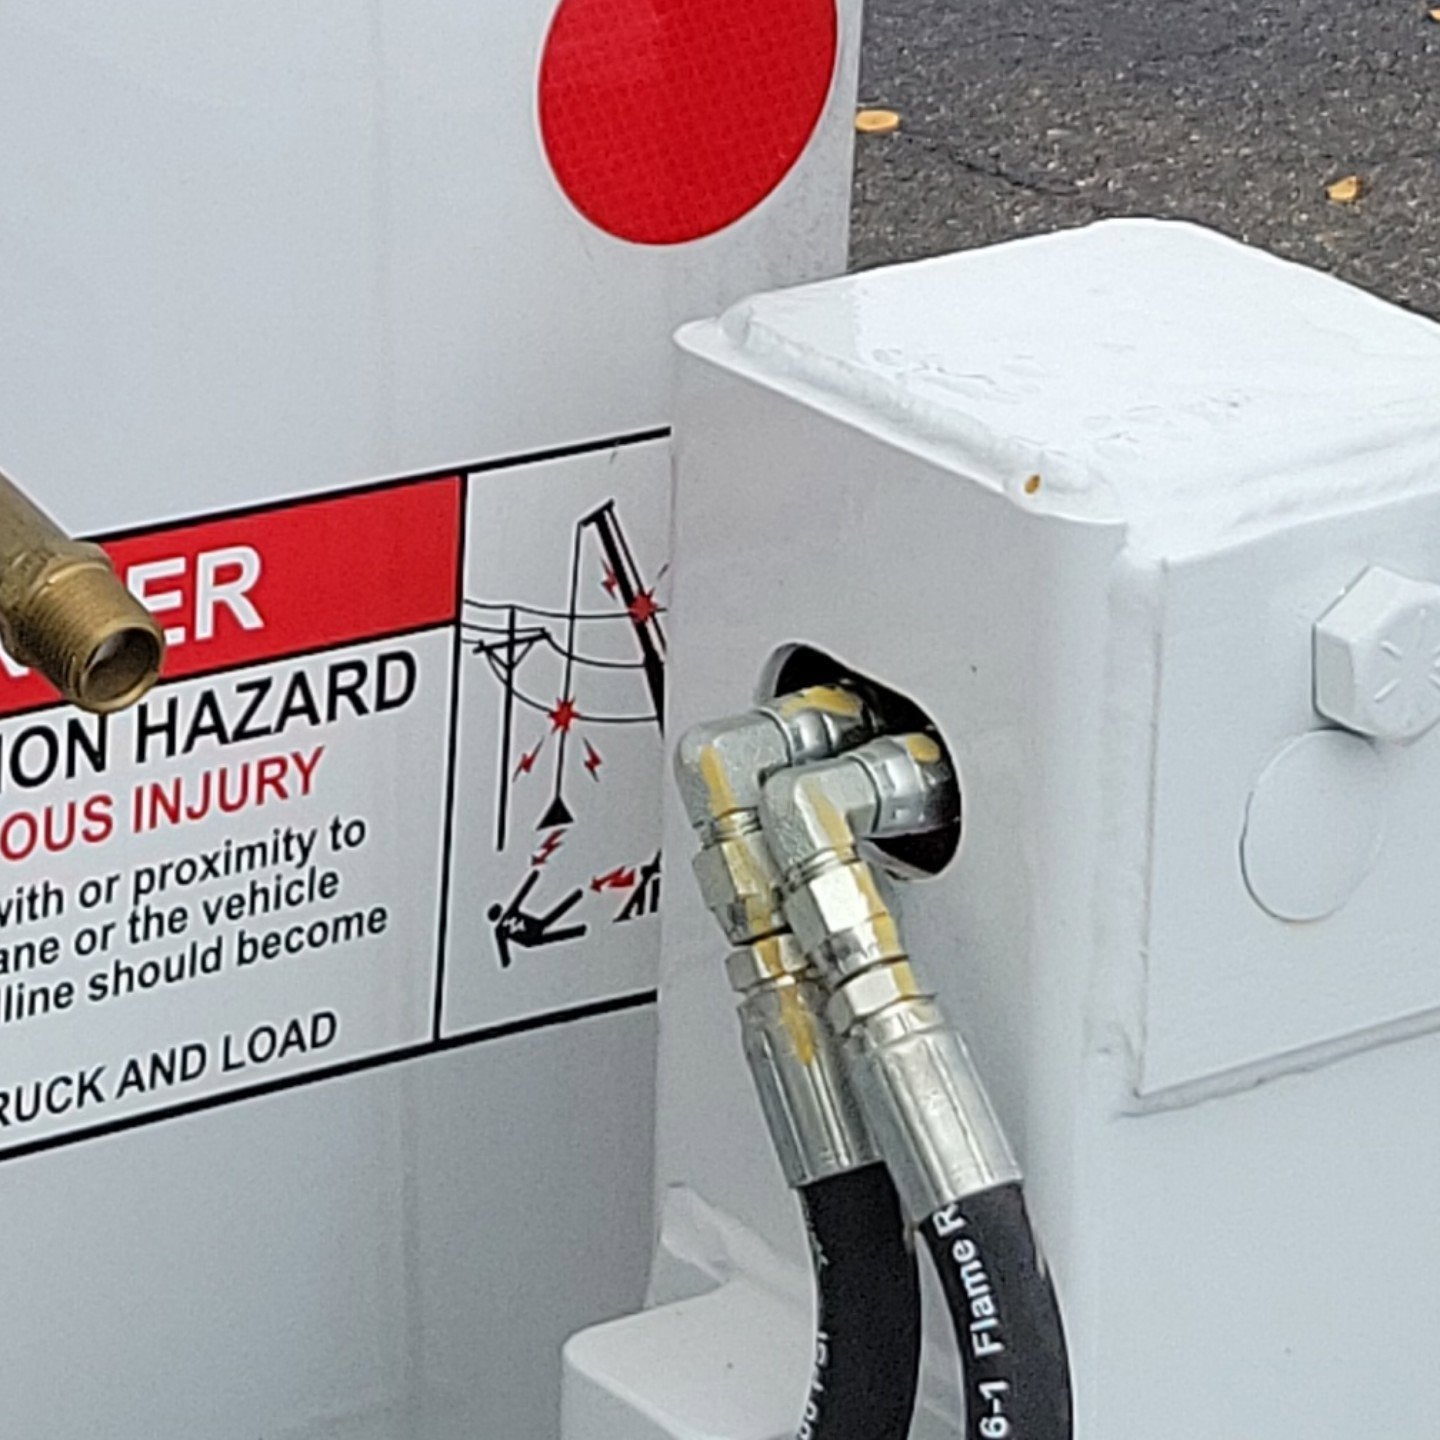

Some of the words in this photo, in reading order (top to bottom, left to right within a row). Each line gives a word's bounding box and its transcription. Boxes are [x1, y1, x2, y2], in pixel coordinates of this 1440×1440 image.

[136, 650, 417, 763] HAZARD
[132, 747, 324, 830] INJURY
[80, 875, 119, 907] or
[134, 829, 316, 906] proximity
[330, 817, 365, 851] to
[75, 923, 115, 955] or
[129, 906, 187, 943] the
[203, 867, 338, 925] vehicle
[88, 941, 222, 1002] should
[237, 907, 388, 966] become
[117, 1044, 206, 1098] AND
[223, 1012, 336, 1071] LOAD
[952, 1239, 1005, 1358] Flame
